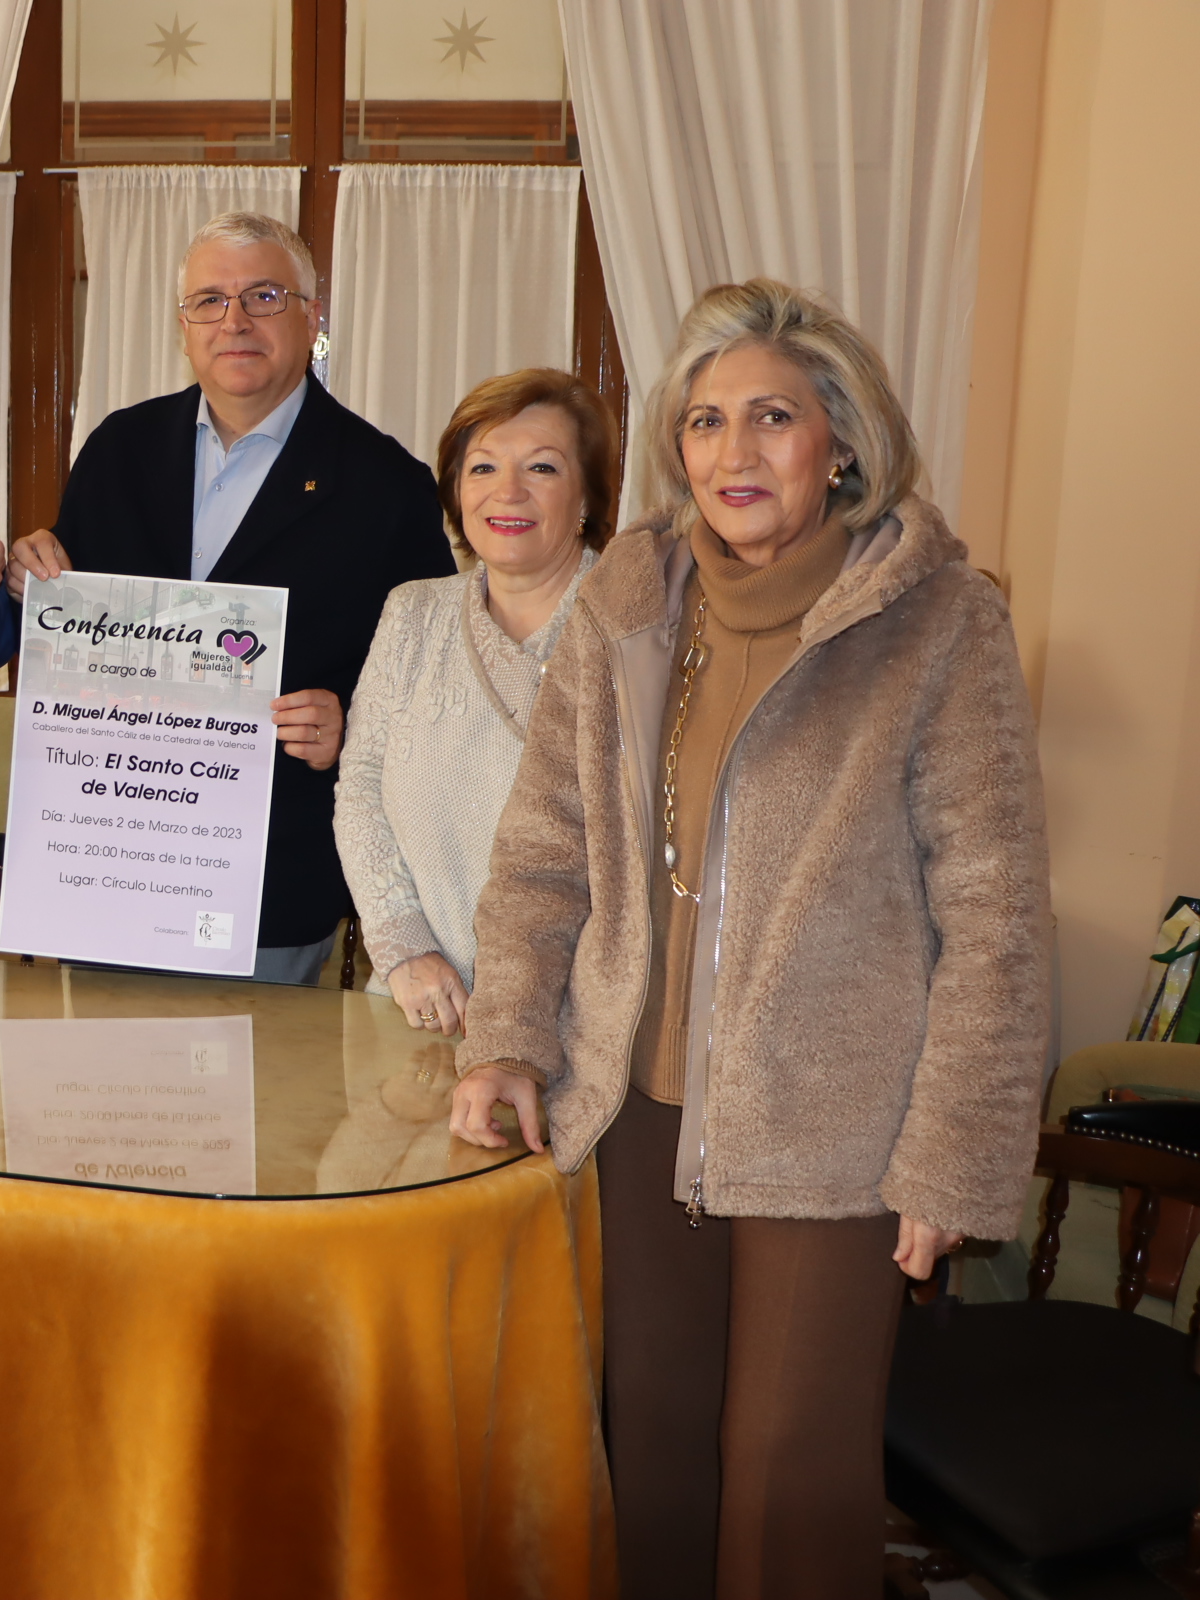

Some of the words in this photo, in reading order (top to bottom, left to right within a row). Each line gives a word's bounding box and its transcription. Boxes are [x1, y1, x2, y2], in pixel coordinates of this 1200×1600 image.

[37, 606, 203, 645] Conferencia
[88, 663, 97, 672] a
[100, 664, 136, 677] cargo
[140, 666, 156, 678] de
[191, 661, 232, 672] igualdad
[192, 651, 230, 662] Mujeres
[33, 701, 48, 715] D.
[53, 703, 105, 720] Miguel
[107, 705, 152, 725] Ángel
[156, 712, 202, 730] López
[205, 717, 258, 736] Burgos
[32, 722, 73, 734] Caballero
[76, 726, 89, 735] del
[91, 728, 115, 737] Santo
[117, 729, 137, 739] Cáliz
[139, 732, 150, 741] de
[153, 733, 161, 742] la
[163, 734, 201, 745] Catedral
[203, 737, 215, 746] de
[217, 739, 255, 750] Valencia
[46, 746, 99, 768] Título:
[105, 753, 122, 769] El
[127, 755, 183, 775] Santo
[190, 761, 239, 780] Cáliz
[82, 779, 106, 795] de
[114, 781, 199, 804] Valencia
[42, 809, 66, 823] Día:
[70, 813, 113, 827] Jueves
[117, 817, 124, 828] 2
[128, 819, 145, 831] de
[149, 820, 187, 834] Marzo
[192, 825, 209, 837] de
[213, 827, 242, 839] 2023
[47, 840, 81, 854] Hora:
[84, 844, 117, 858] 20:00
[121, 848, 155, 862] horas
[159, 852, 176, 864] de
[180, 854, 192, 866] la
[195, 856, 230, 869] tarde
[59, 872, 98, 887] Lugar:
[102, 875, 146, 891] Círculo
[150, 881, 213, 898] Lucentino
